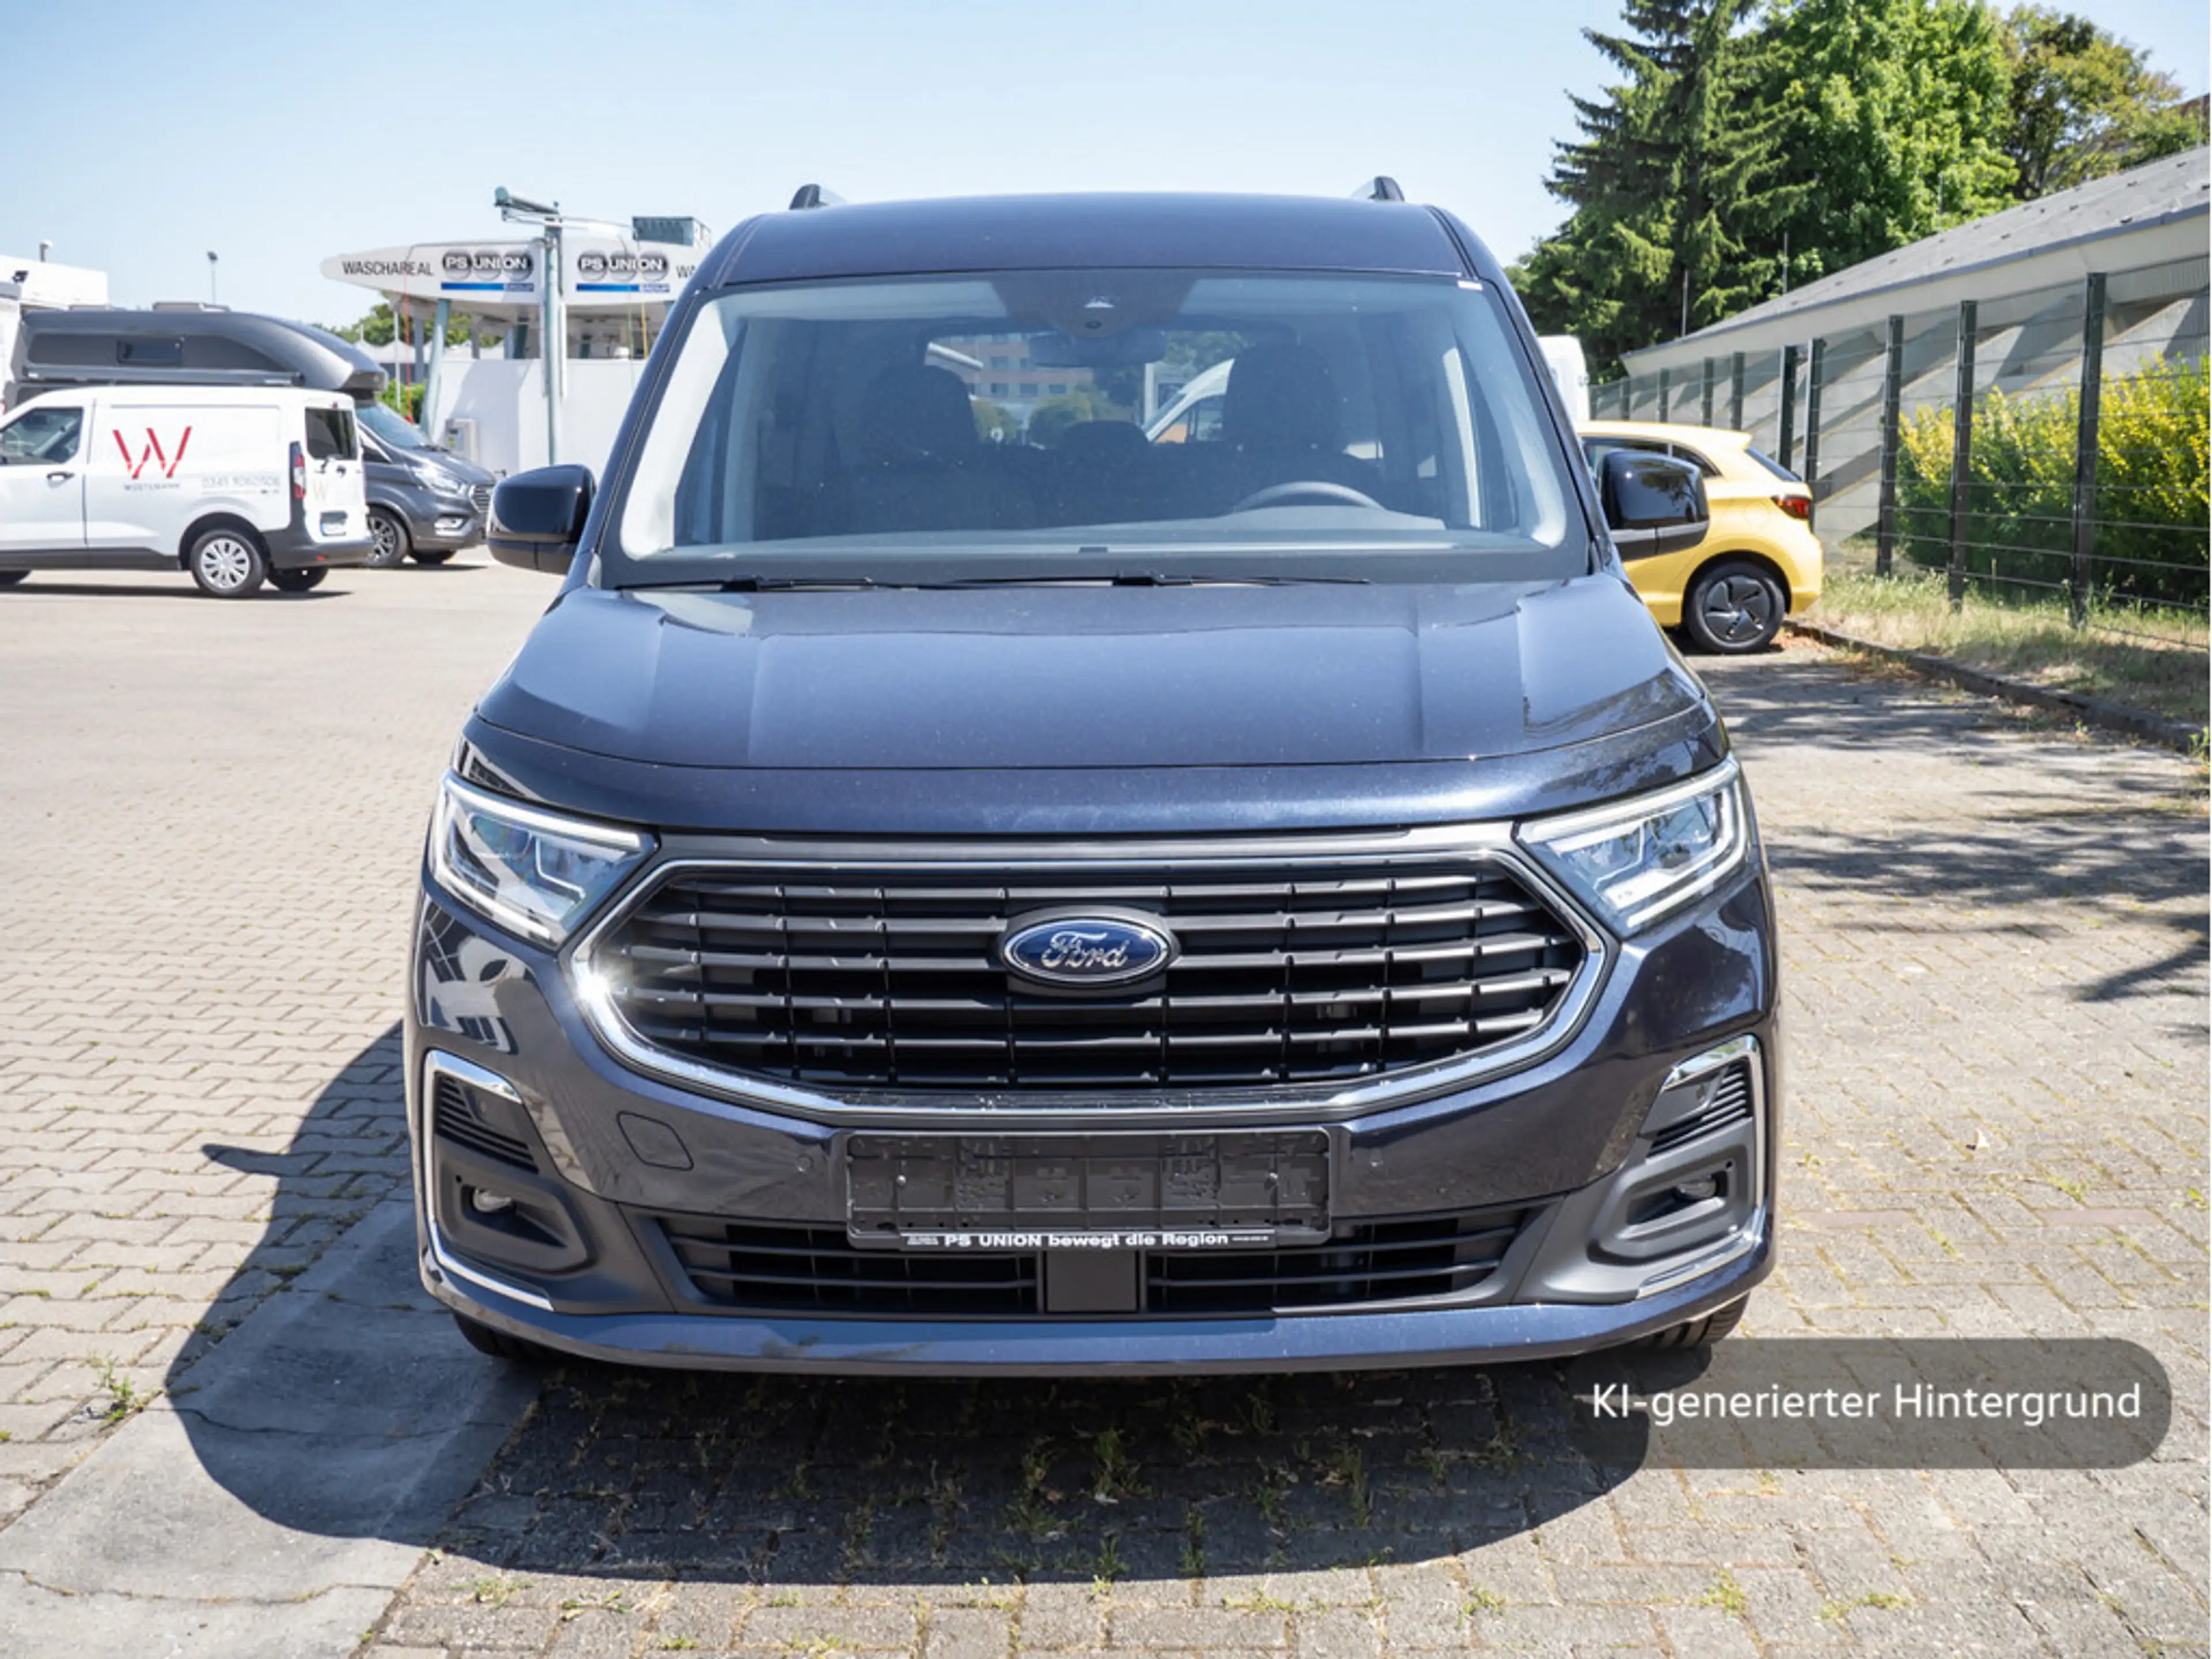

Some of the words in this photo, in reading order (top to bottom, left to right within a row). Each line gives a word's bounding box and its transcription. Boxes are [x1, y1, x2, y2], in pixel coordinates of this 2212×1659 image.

[342, 260, 434, 276] WASCHAREAL
[446, 256, 467, 270] PS
[473, 256, 527, 270] UNION
[581, 257, 604, 271] PS
[609, 257, 662, 271] UNION
[1041, 930, 1130, 968] Ford
[944, 1234, 971, 1247] PS
[979, 1234, 1043, 1247] UNION
[1048, 1234, 1120, 1249] bewegt
[1125, 1233, 1156, 1246] die
[1162, 1233, 1228, 1247] Region
